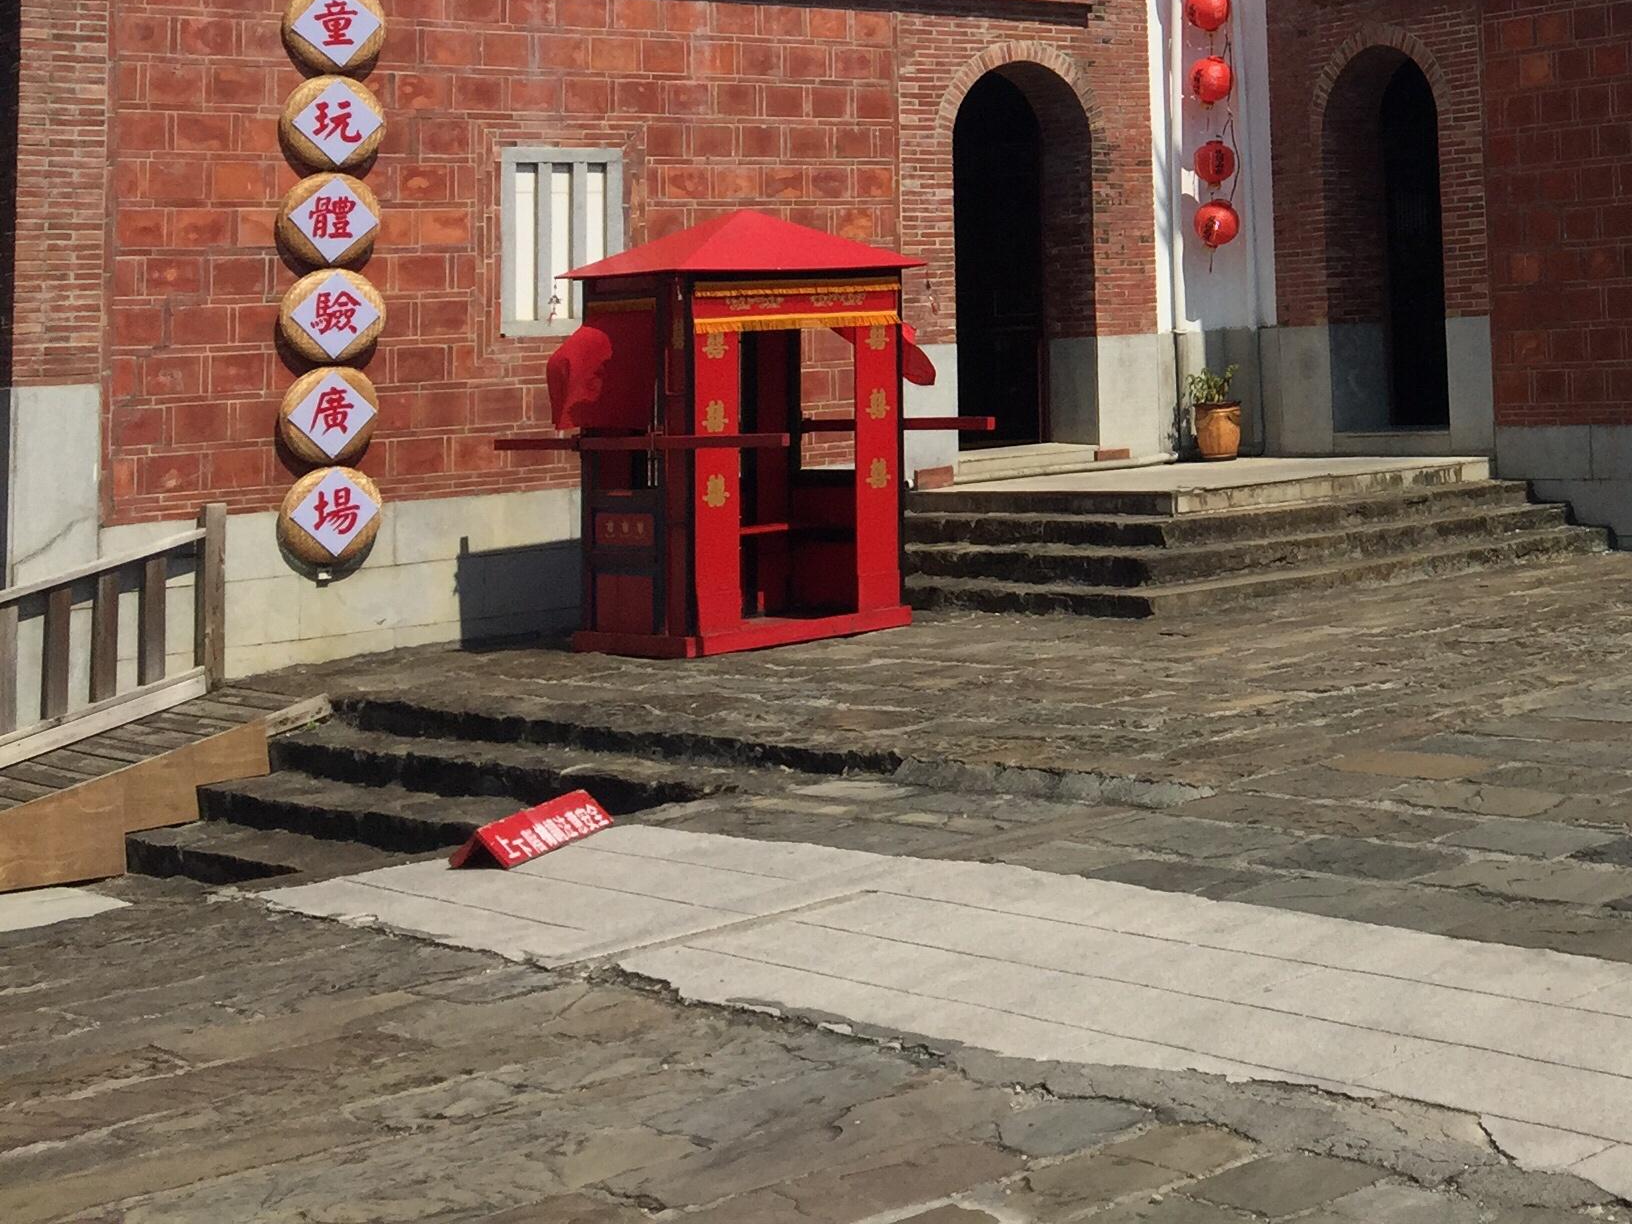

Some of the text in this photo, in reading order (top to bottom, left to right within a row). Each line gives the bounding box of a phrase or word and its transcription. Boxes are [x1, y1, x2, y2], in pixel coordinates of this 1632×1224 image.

[308, 0, 363, 536] 童玩體驗廣場
